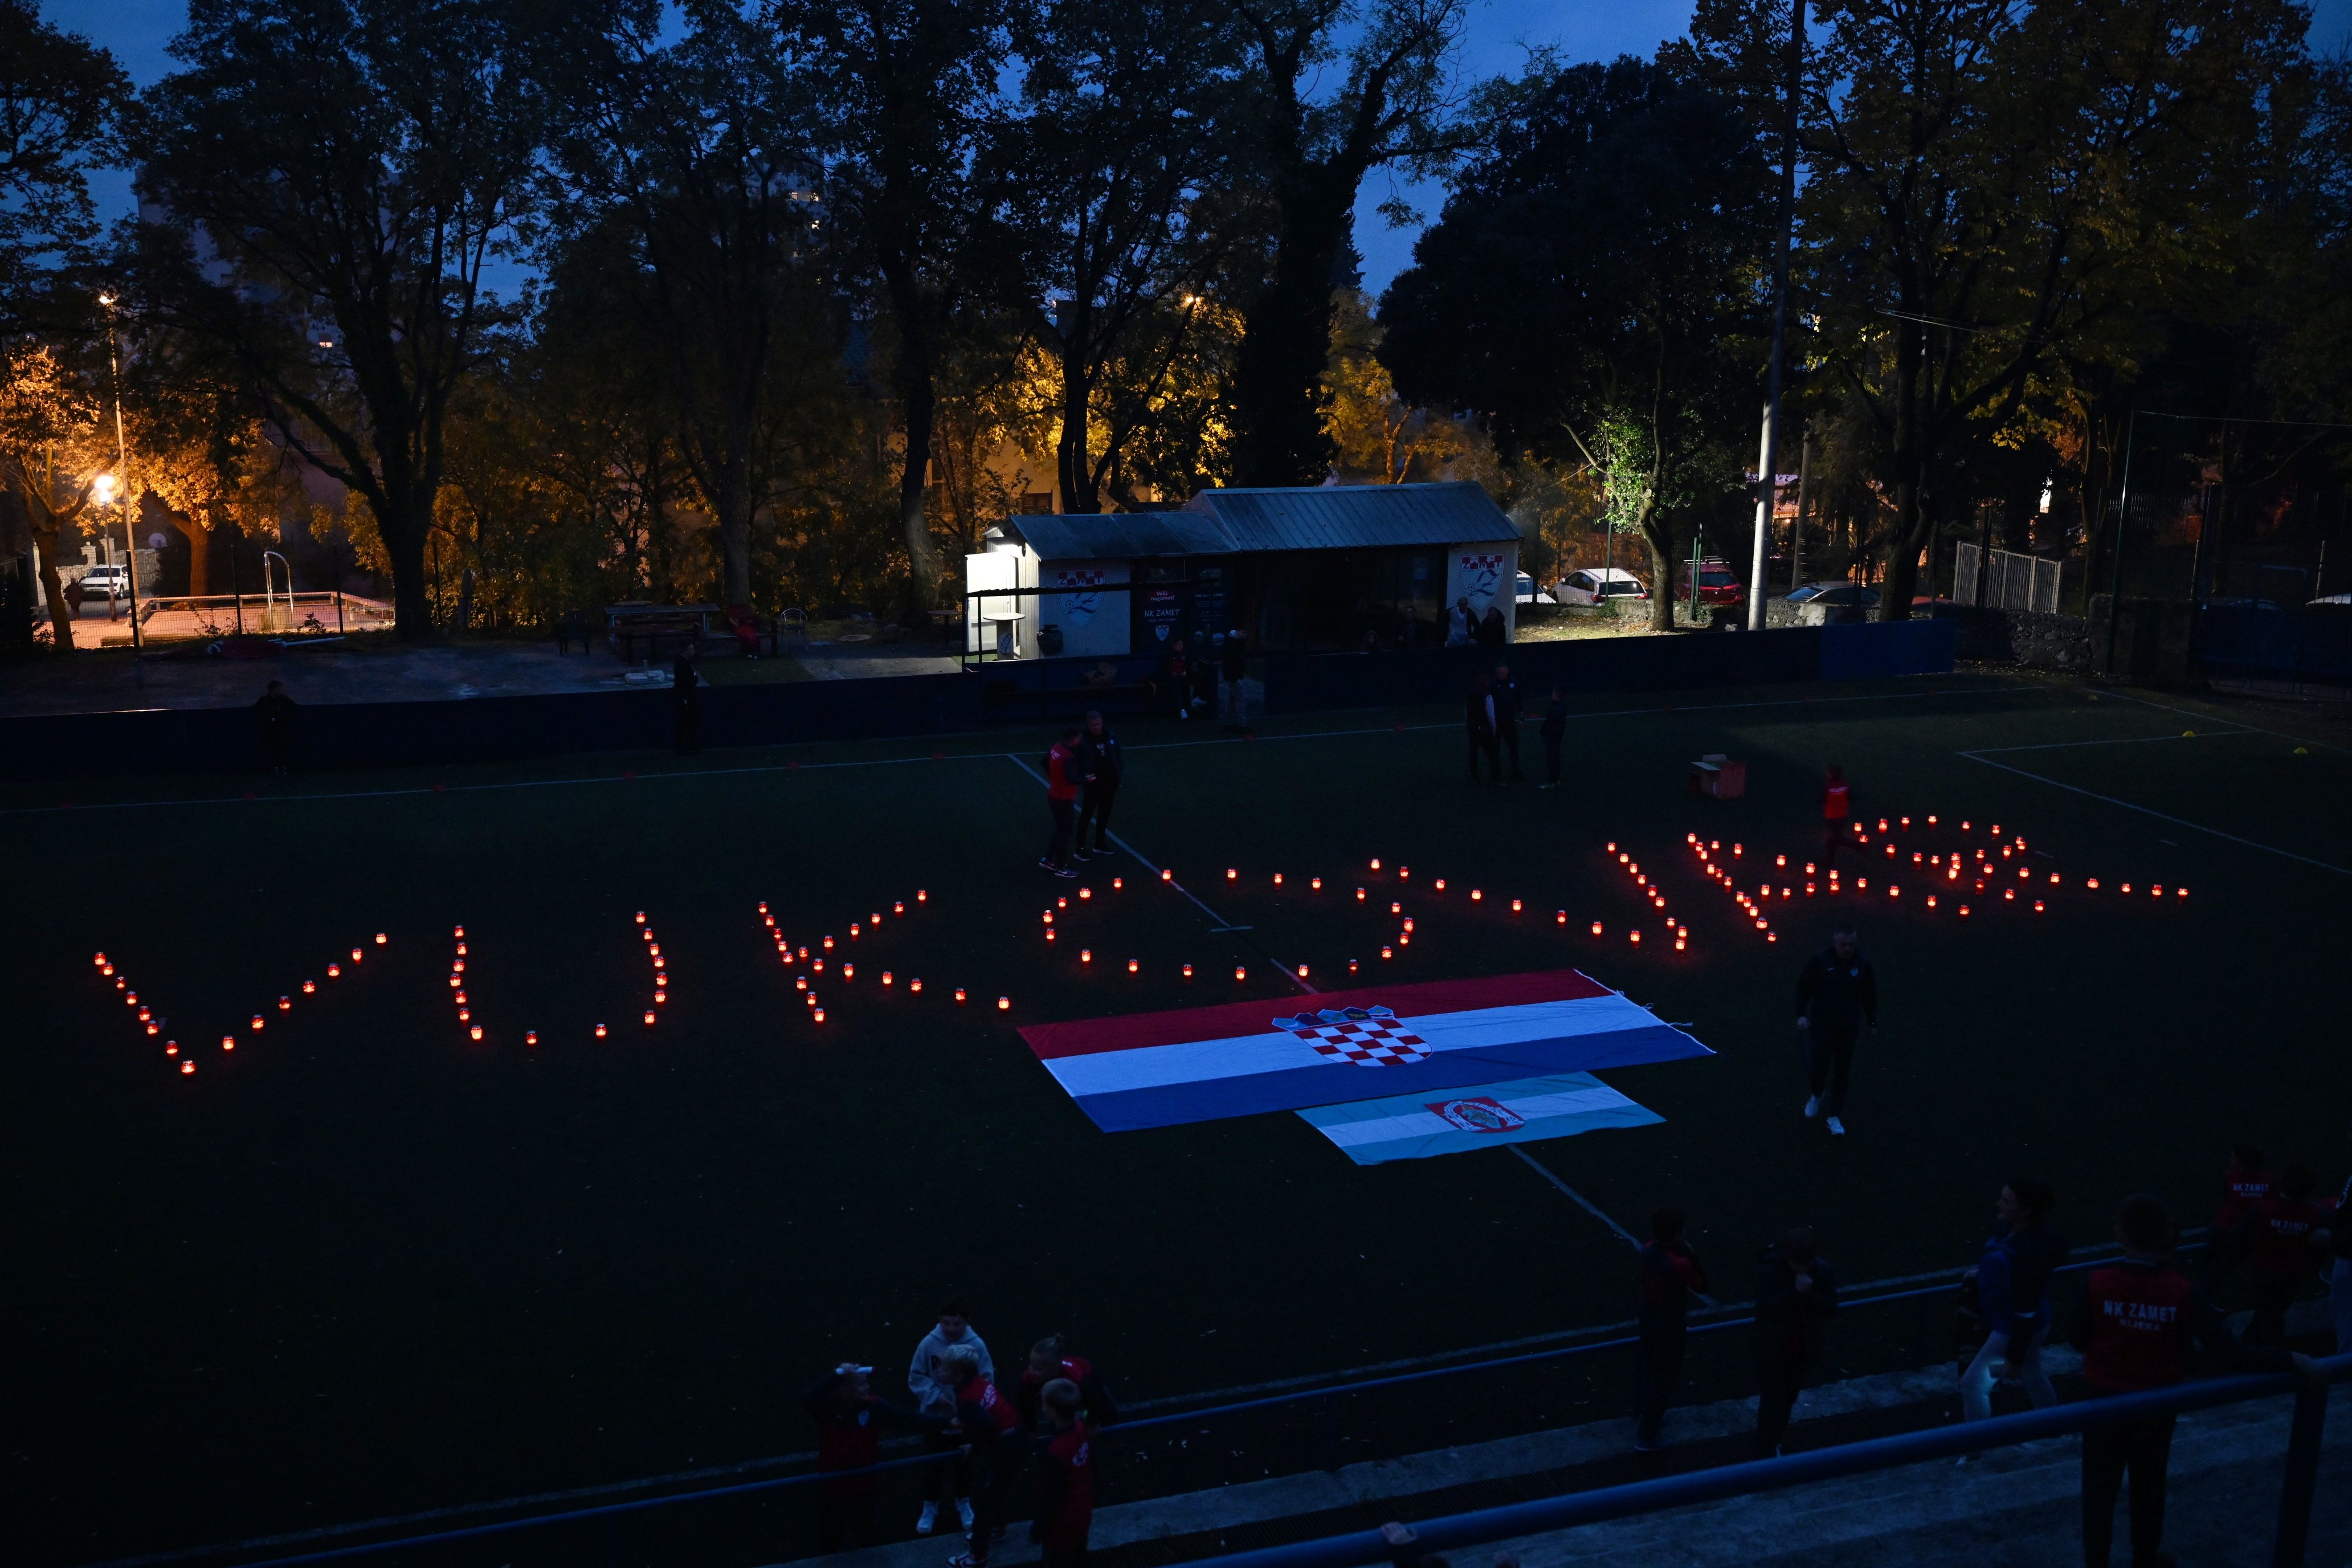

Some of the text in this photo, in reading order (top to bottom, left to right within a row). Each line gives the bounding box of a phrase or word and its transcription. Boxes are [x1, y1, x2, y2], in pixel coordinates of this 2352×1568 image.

[2233, 1182, 2270, 1193] NK ZAMET
[2104, 1298, 2178, 1322] NK ZAMET
